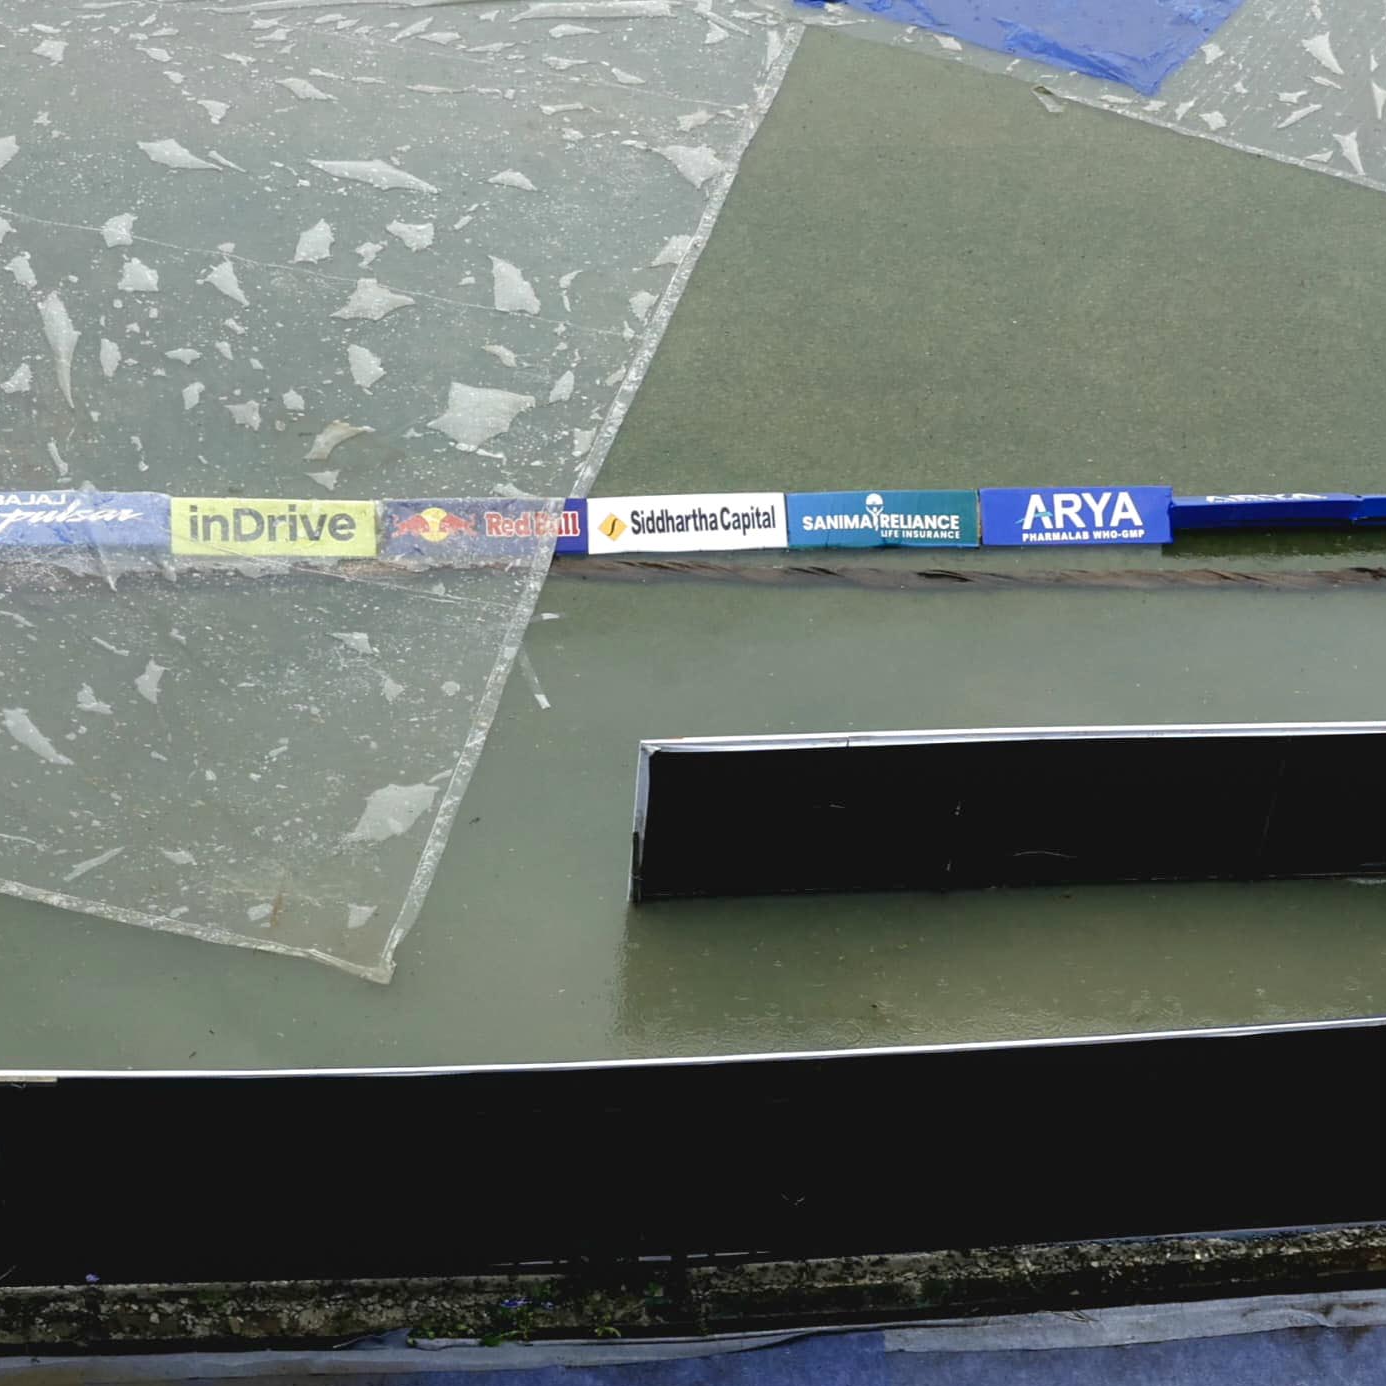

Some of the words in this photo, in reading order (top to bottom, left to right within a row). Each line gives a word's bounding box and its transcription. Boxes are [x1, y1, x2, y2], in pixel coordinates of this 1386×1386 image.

[189, 504, 356, 542] inDrive
[630, 507, 719, 535] Siddhartha
[719, 505, 776, 536] Capital
[802, 514, 870, 531] SANIMA
[880, 513, 960, 530] RELIANCE
[1022, 491, 1143, 530] ARYA
[484, 512, 532, 537] Red
[881, 530, 900, 538] LIFE
[902, 530, 961, 539] INSURANCE
[1022, 531, 1090, 542] PHARMALAB
[1093, 529, 1145, 539] WHO-GMP
